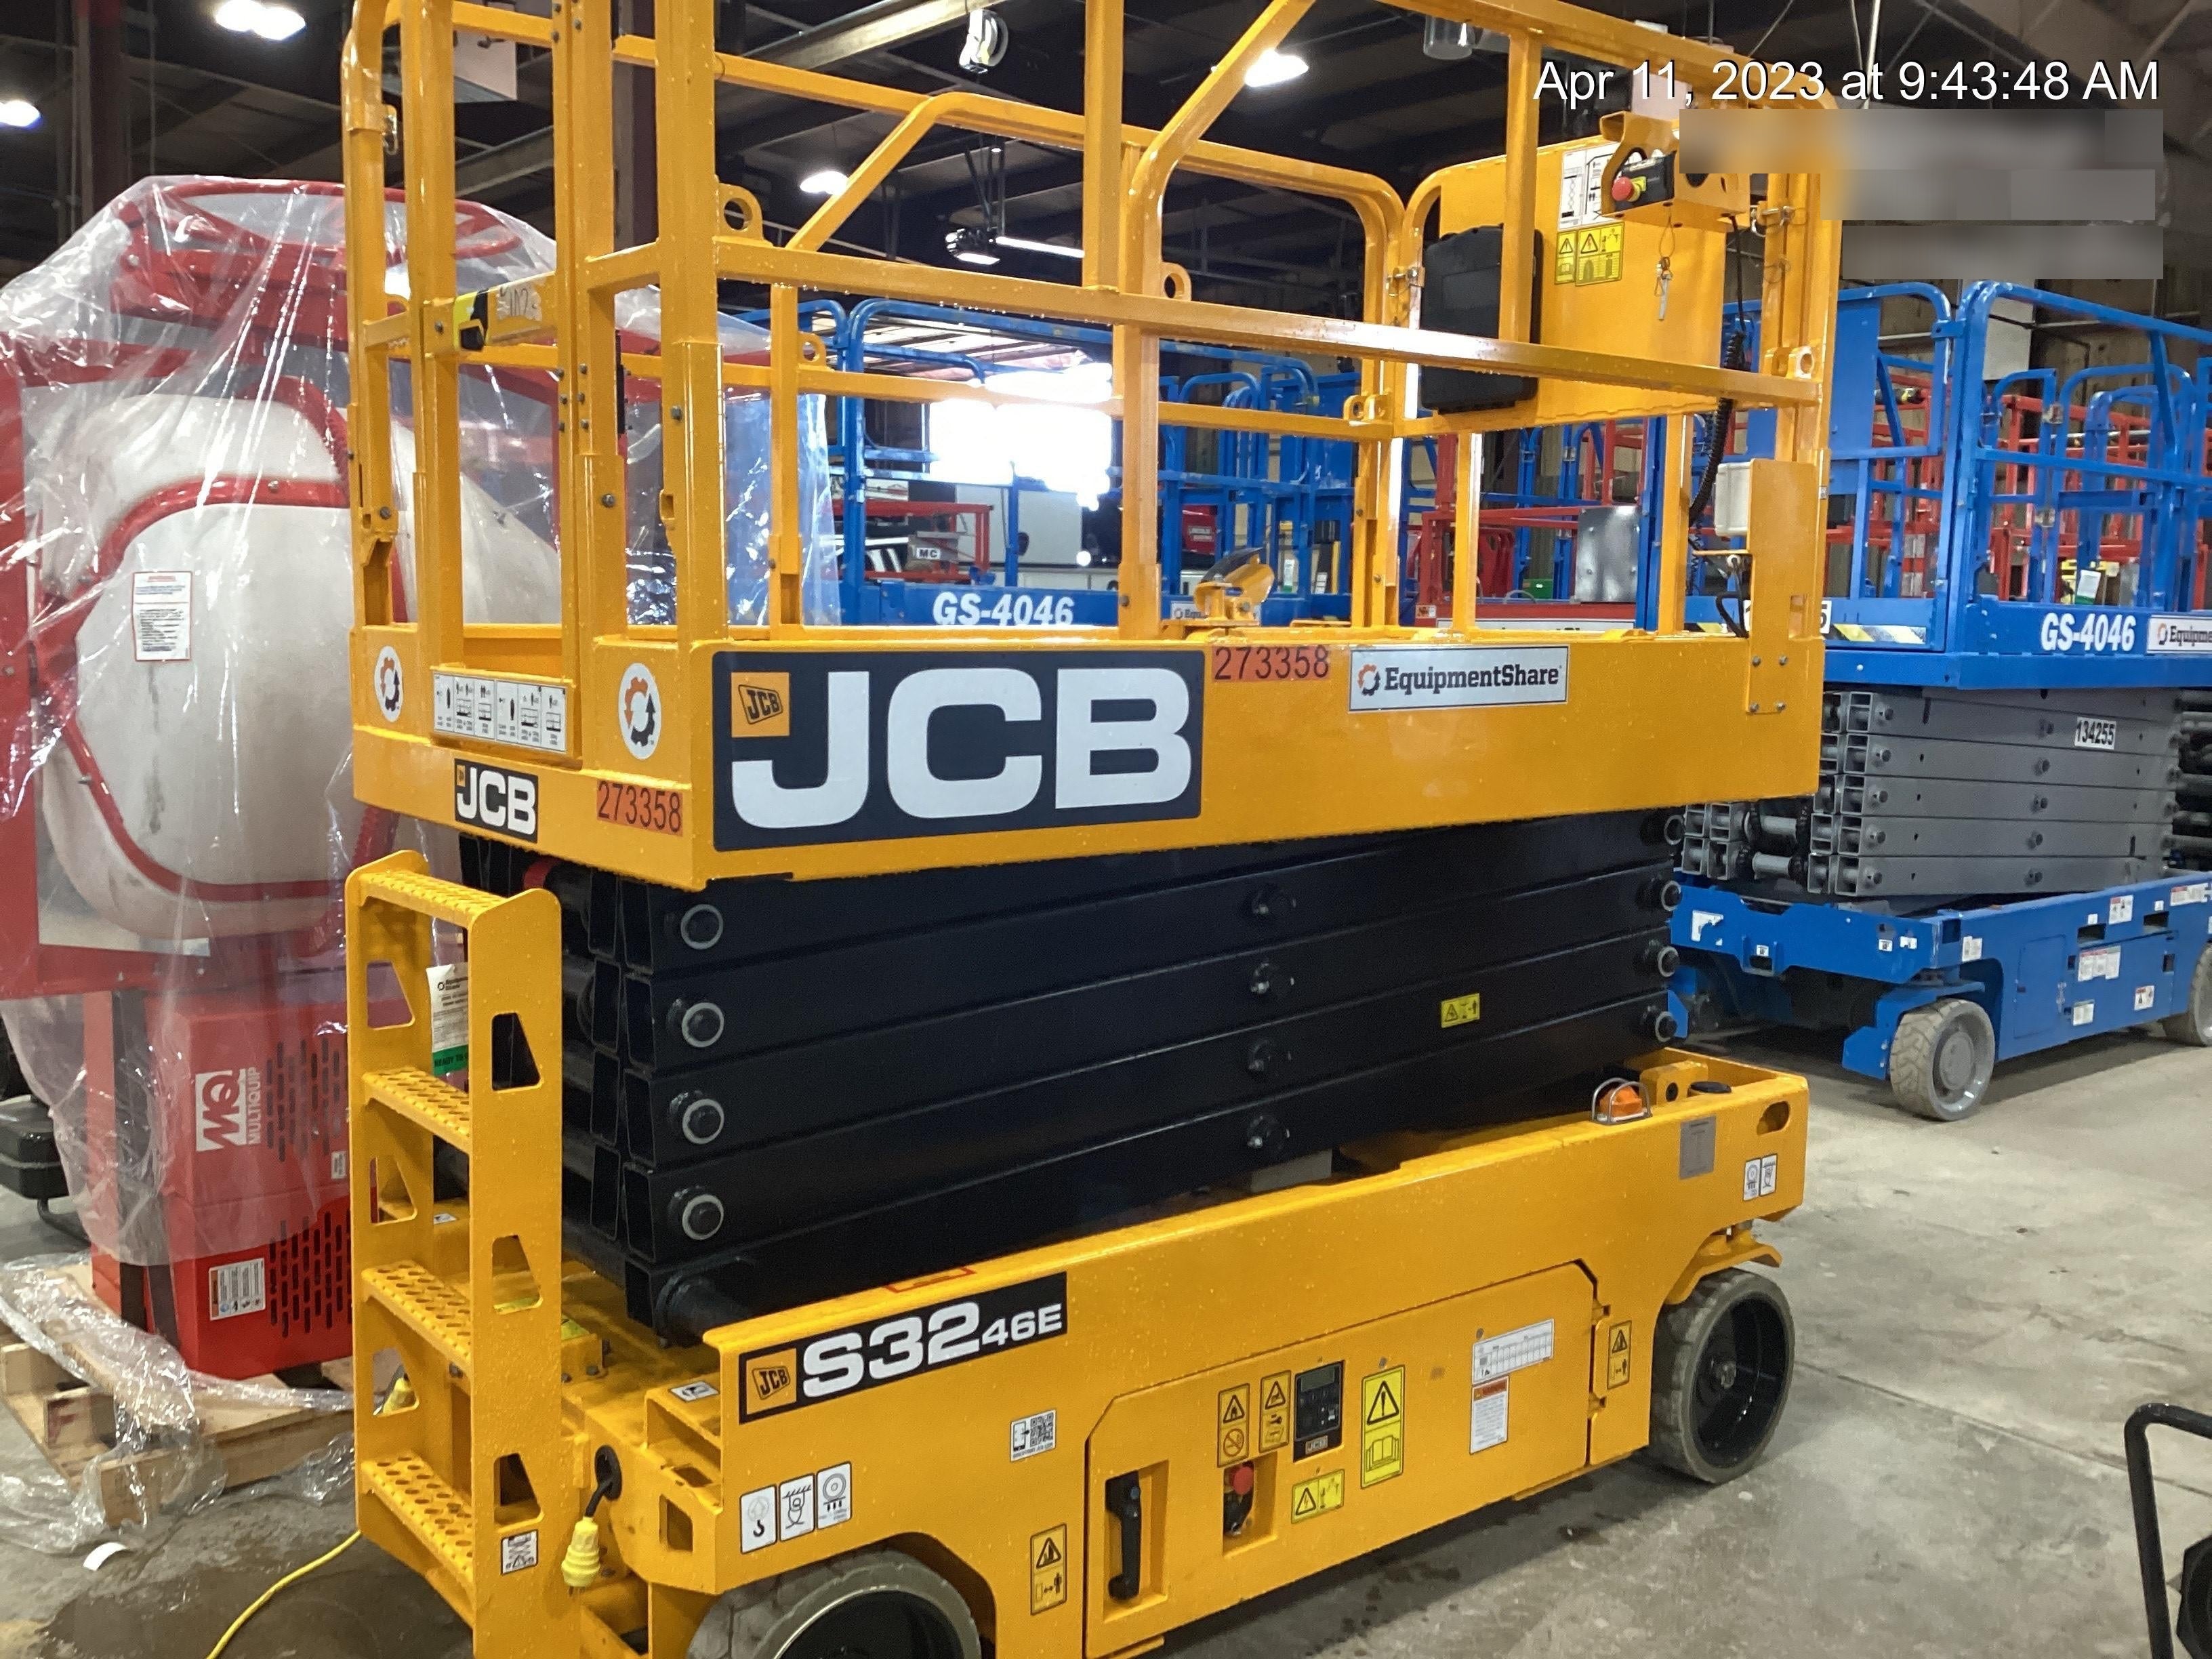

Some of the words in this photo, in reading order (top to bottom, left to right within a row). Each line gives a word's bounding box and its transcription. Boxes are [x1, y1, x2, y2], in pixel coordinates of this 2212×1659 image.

[933, 591, 1075, 626] GS-4046
[2041, 612, 2137, 651] GS-4046
[1214, 644, 1330, 680] 273358
[1384, 663, 1559, 695] EquipmentShare
[745, 689, 781, 720] JCB
[732, 668, 1191, 830] JCB
[2076, 720, 2115, 745] 134255
[456, 766, 537, 835] JCB
[597, 779, 682, 833] 273358
[247, 1067, 262, 1145] MULTIQUIP
[758, 1369, 788, 1395] JCB
